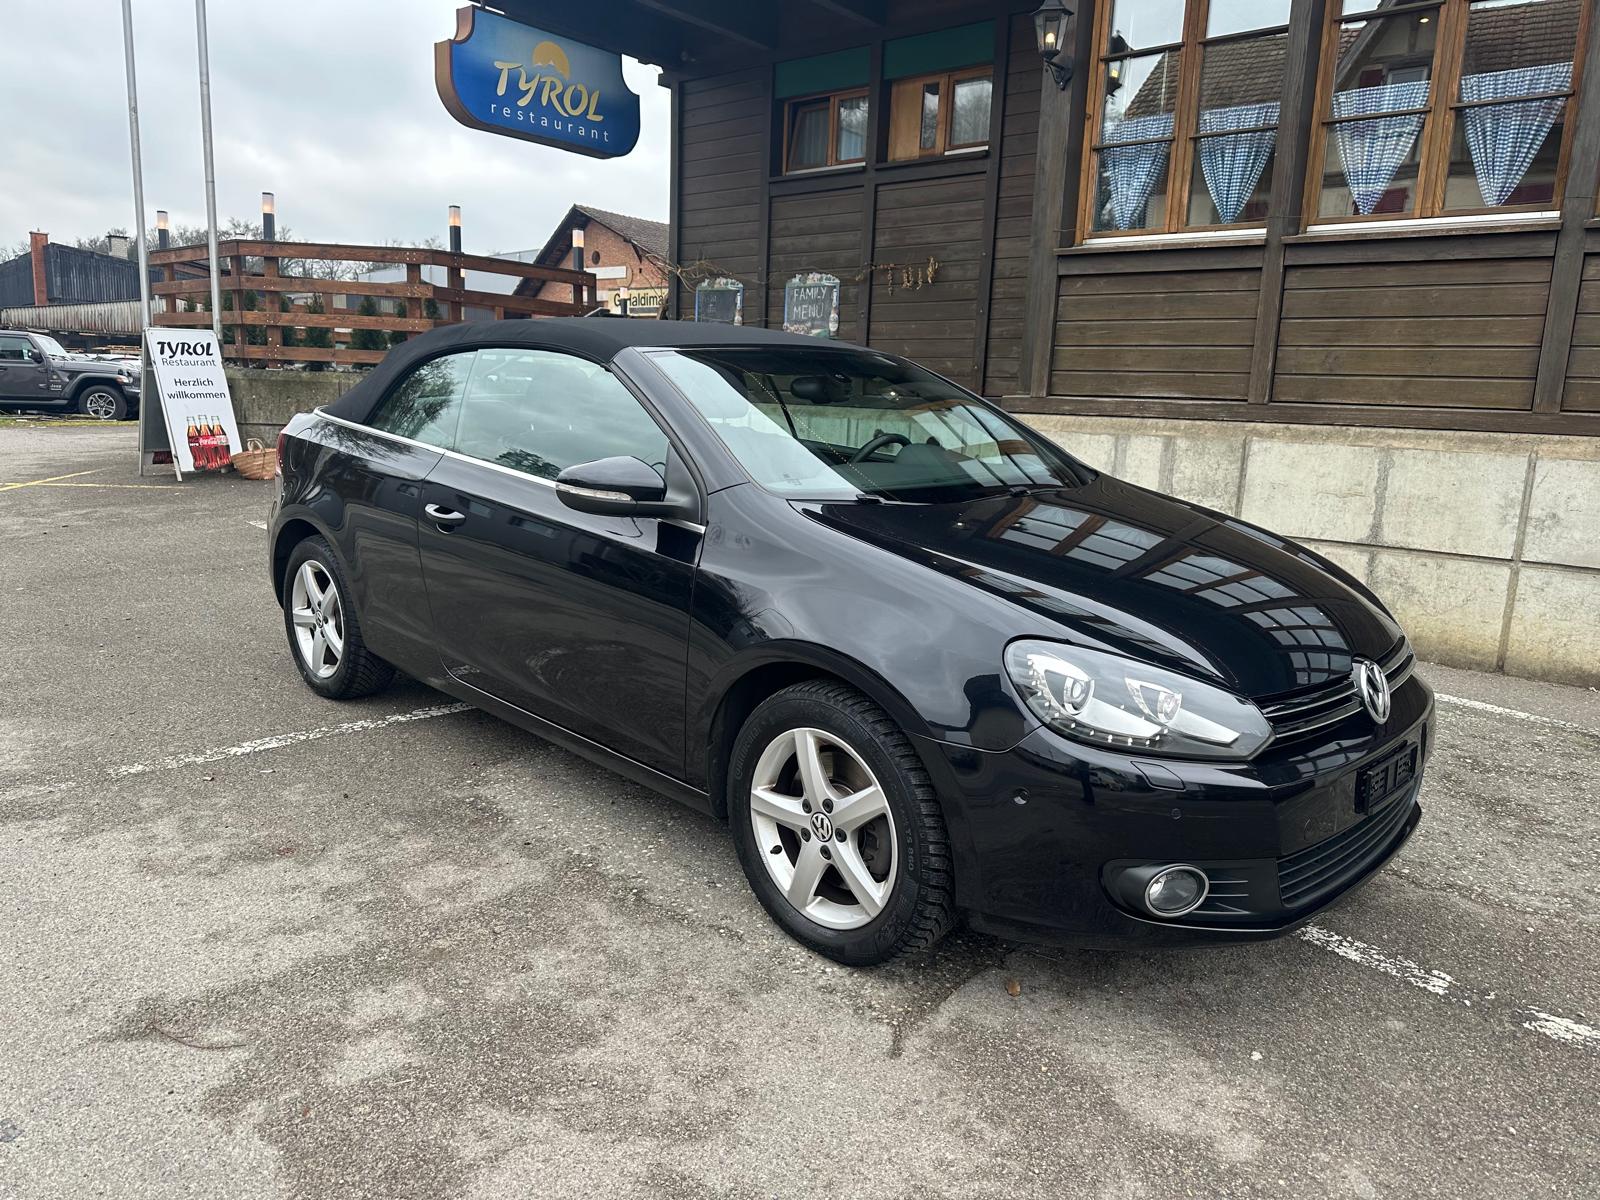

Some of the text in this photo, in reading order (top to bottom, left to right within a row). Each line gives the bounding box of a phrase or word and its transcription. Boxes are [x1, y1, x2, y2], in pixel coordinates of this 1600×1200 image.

[494, 61, 604, 122] TYROL
[491, 103, 609, 142] restaurant
[793, 287, 827, 300] FAMILY
[793, 304, 824, 320] MENU
[157, 341, 214, 359] TYROL
[162, 357, 217, 367] Restaurant
[174, 378, 214, 387] Herzlich
[167, 390, 226, 400] willkommen
